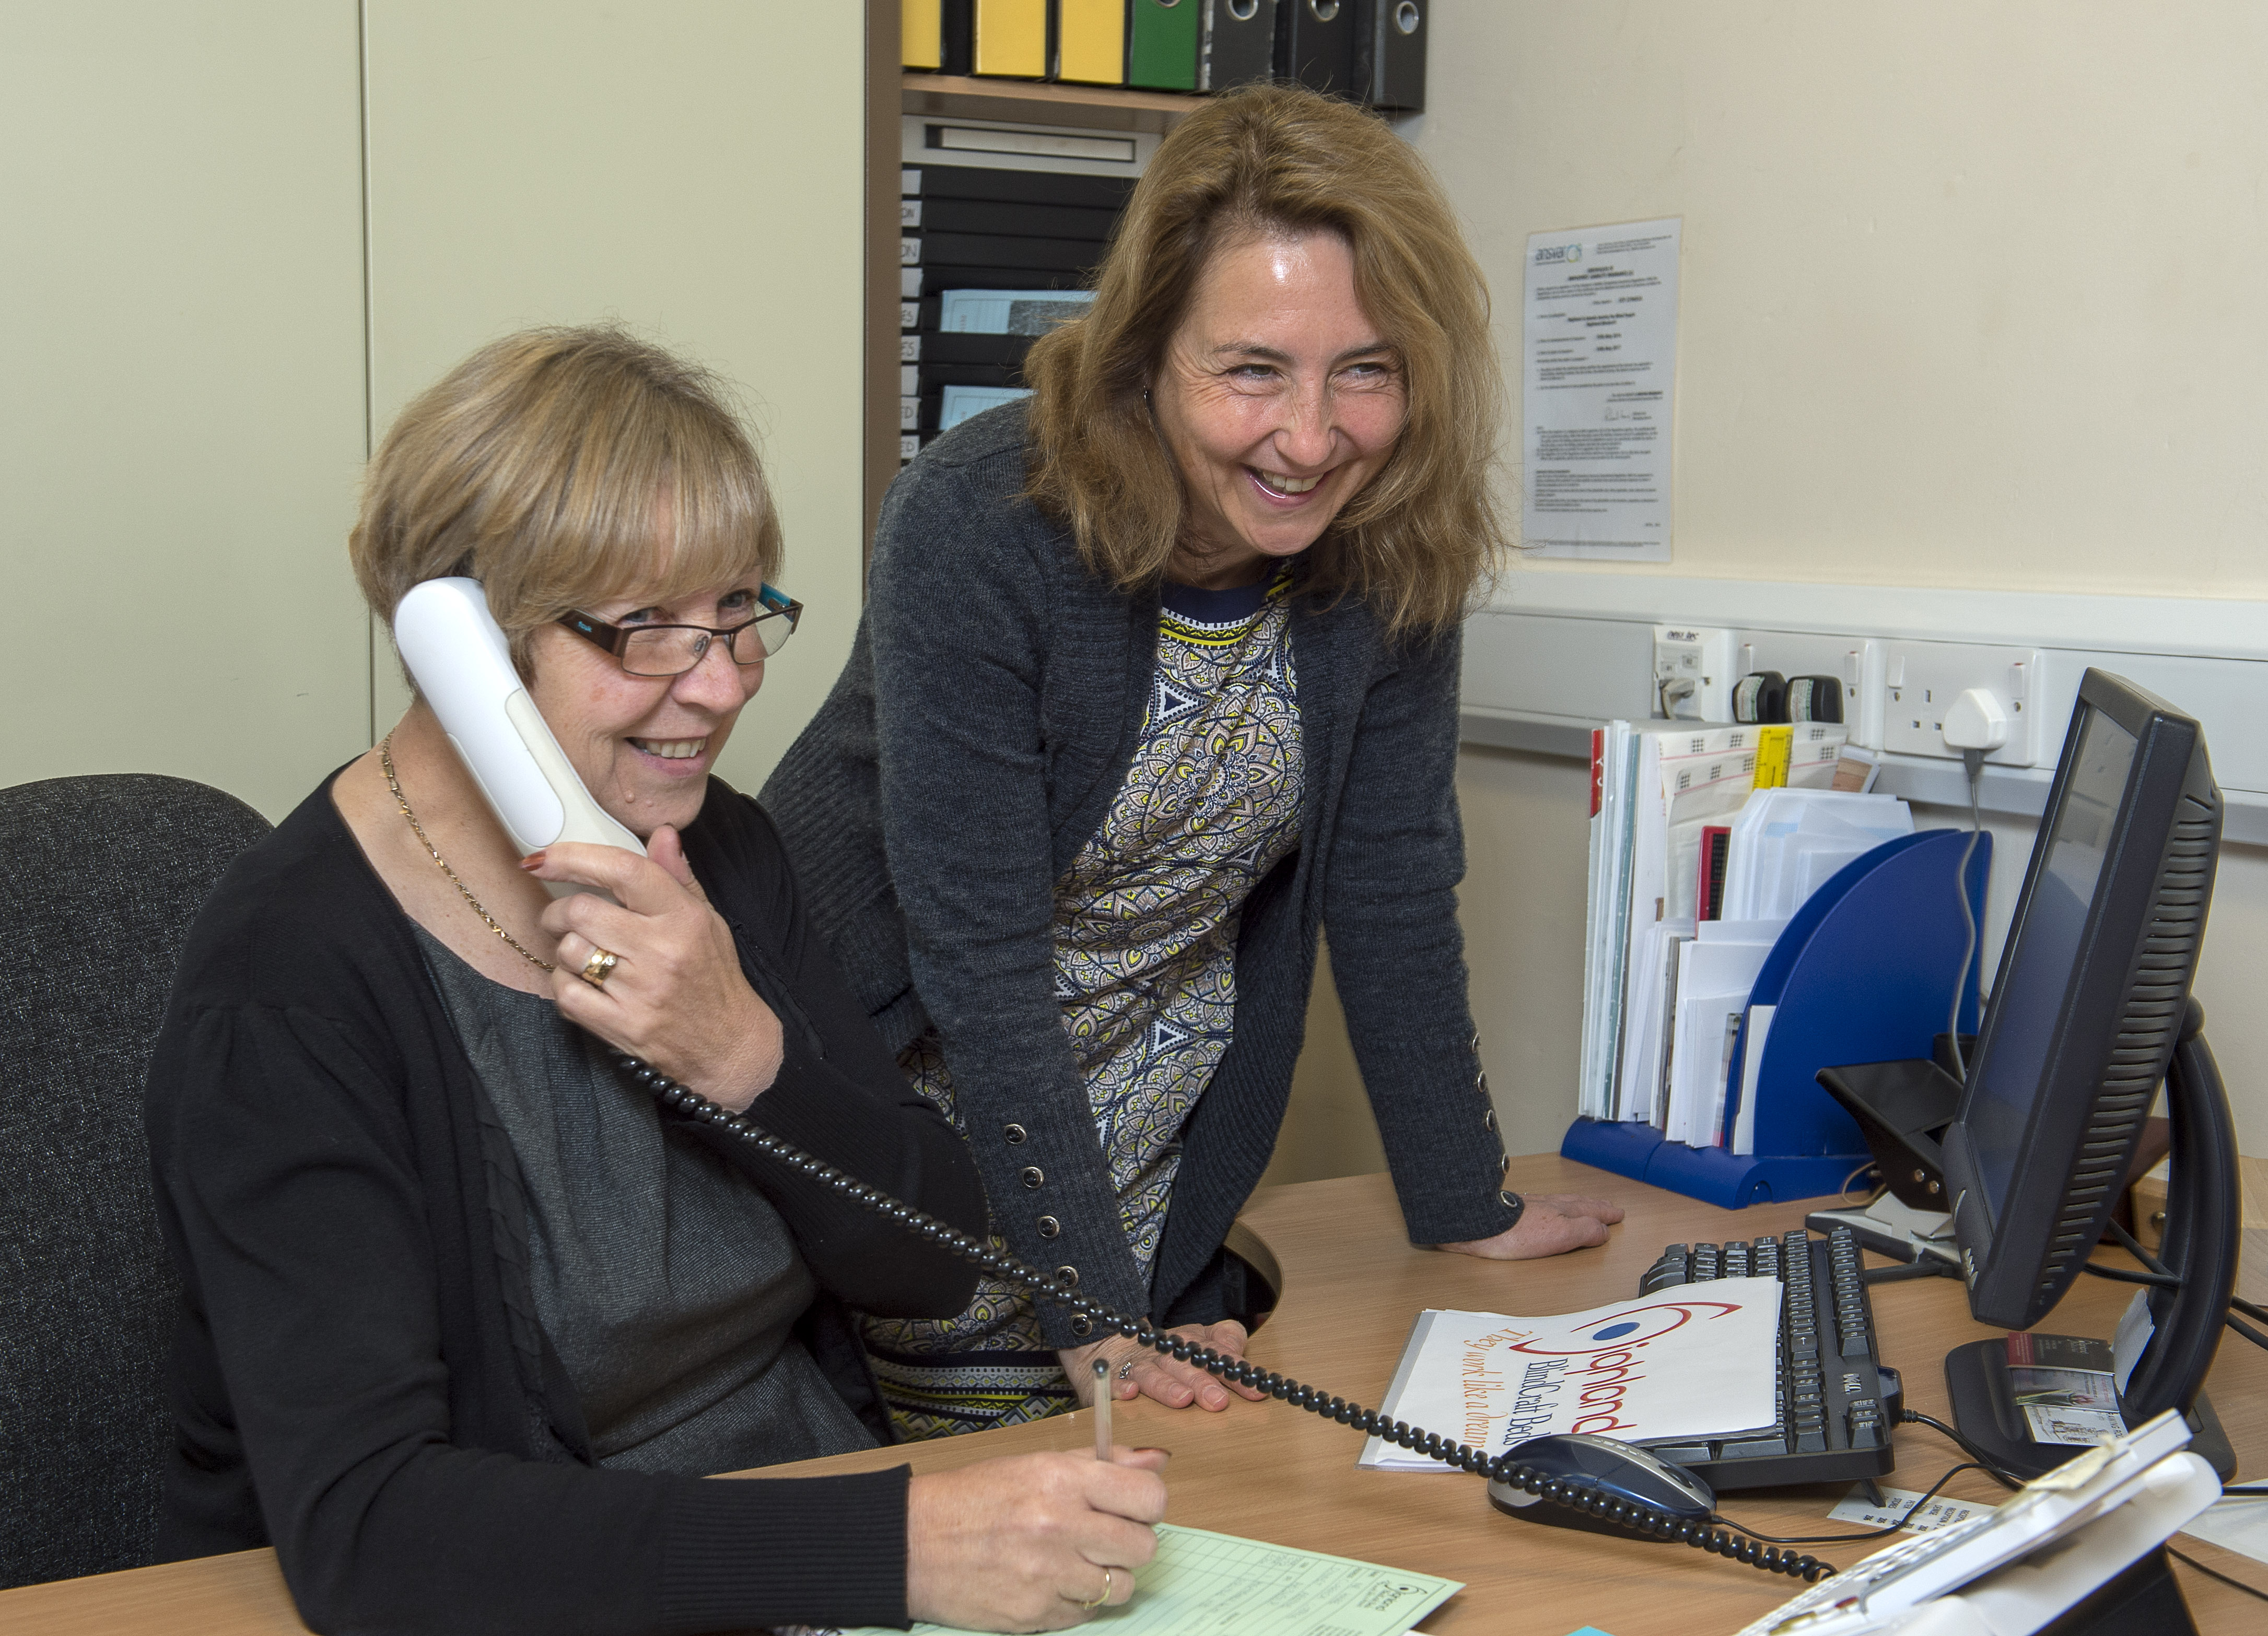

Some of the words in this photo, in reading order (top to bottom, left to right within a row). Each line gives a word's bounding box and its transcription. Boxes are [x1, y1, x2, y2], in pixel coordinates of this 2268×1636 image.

[1464, 1328, 1534, 1351] They
[1463, 1352, 1502, 1376] work
[1463, 1380, 1505, 1399] like
[1513, 1358, 1569, 1414] BlindCraft
[1463, 1411, 1509, 1448] dream
[1503, 1413, 1553, 1445] Beds
[2106, 1413, 2120, 1429] RAWING
